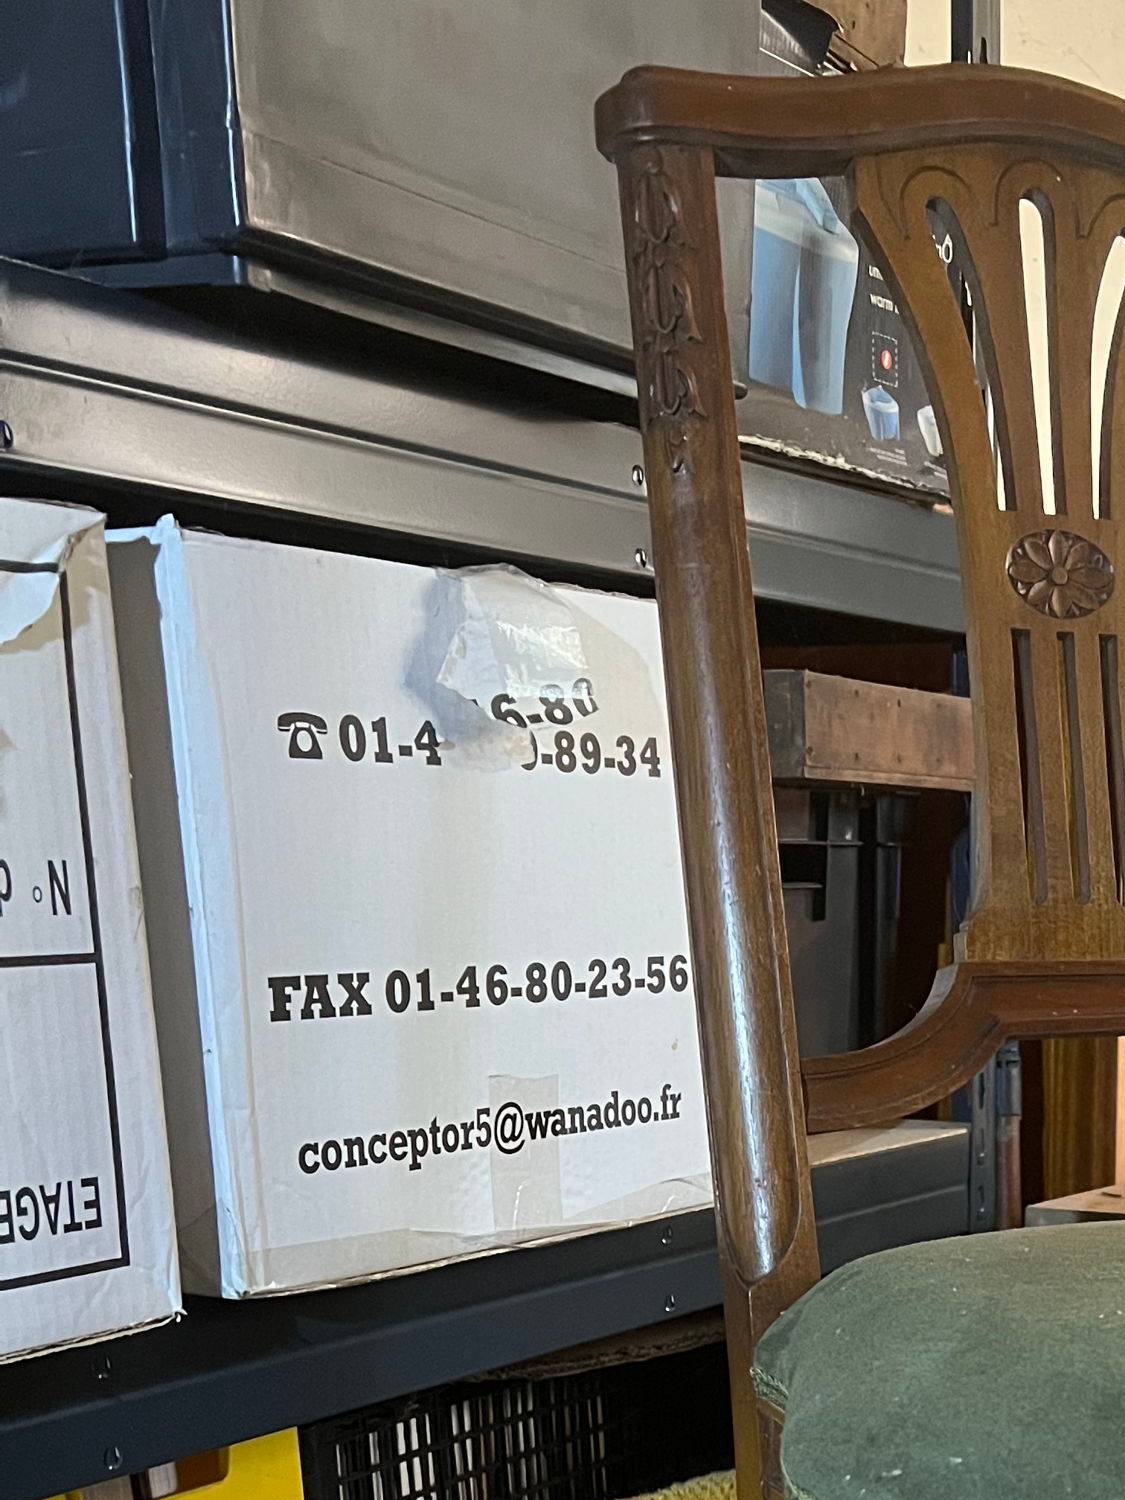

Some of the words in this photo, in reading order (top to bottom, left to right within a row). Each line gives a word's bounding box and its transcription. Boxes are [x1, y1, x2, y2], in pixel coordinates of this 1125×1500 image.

[267, 972, 373, 1023] FAX
[385, 954, 688, 1014] 01-46-80-23-56
[298, 1083, 682, 1175] conceptor5@wanadoo.fr
